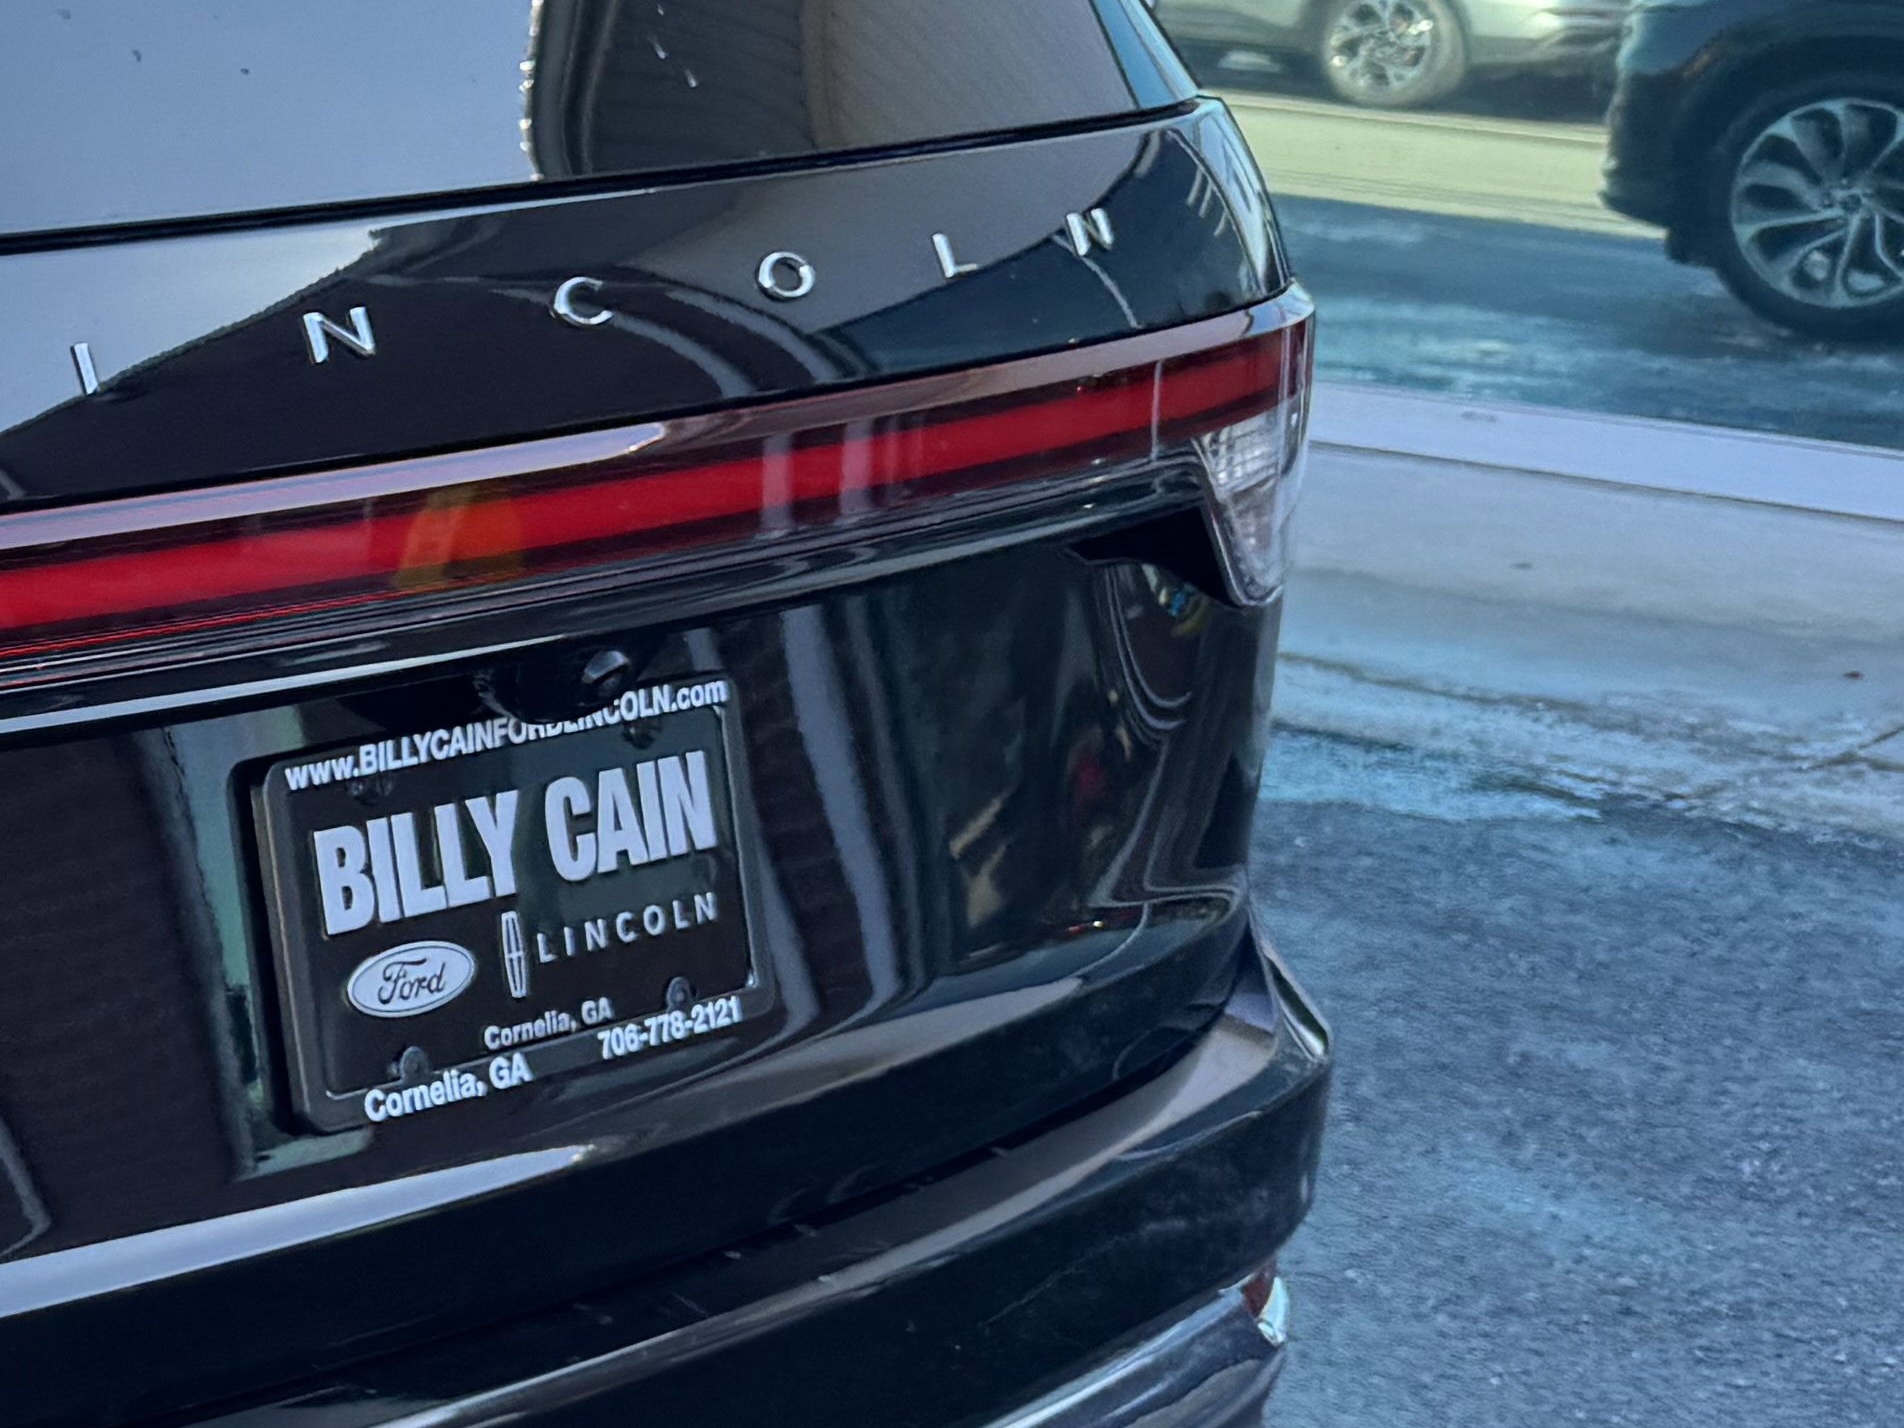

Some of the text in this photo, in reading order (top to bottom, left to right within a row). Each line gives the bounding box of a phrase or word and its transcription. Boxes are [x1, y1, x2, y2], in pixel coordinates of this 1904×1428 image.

[314, 750, 719, 935] BILLY CAIN
[537, 891, 718, 963] LINCOLN
[484, 996, 615, 1051] Cornelia, GA
[598, 995, 744, 1060] 706-778-2121
[364, 1052, 535, 1122] Cornelia, GA
